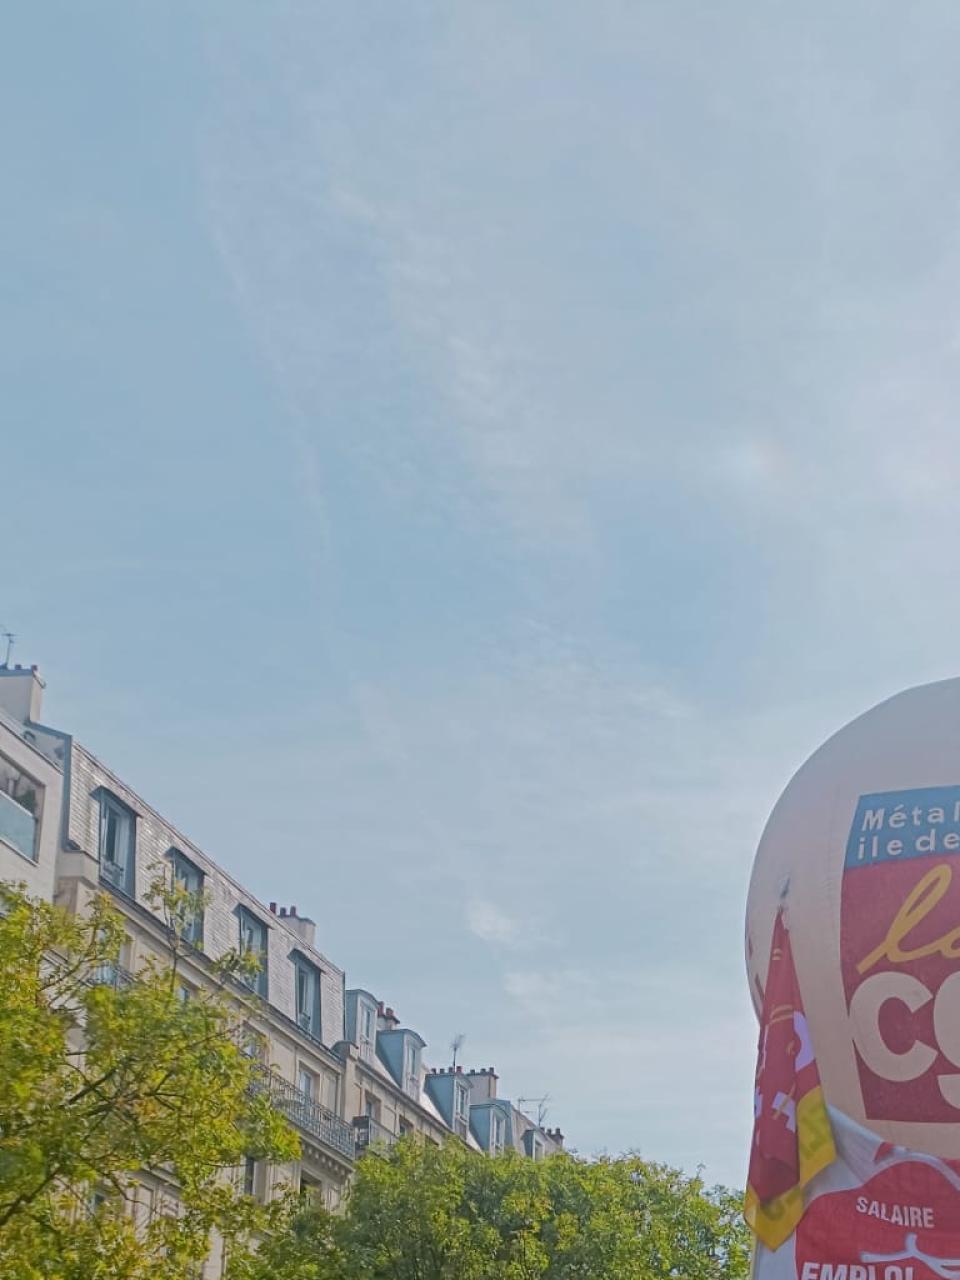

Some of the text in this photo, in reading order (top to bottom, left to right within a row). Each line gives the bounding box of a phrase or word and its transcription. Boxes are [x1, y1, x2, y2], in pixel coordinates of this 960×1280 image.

[856, 834, 903, 860] ile
[914, 828, 960, 853] de
[855, 1196, 935, 1229] SALAIRE
